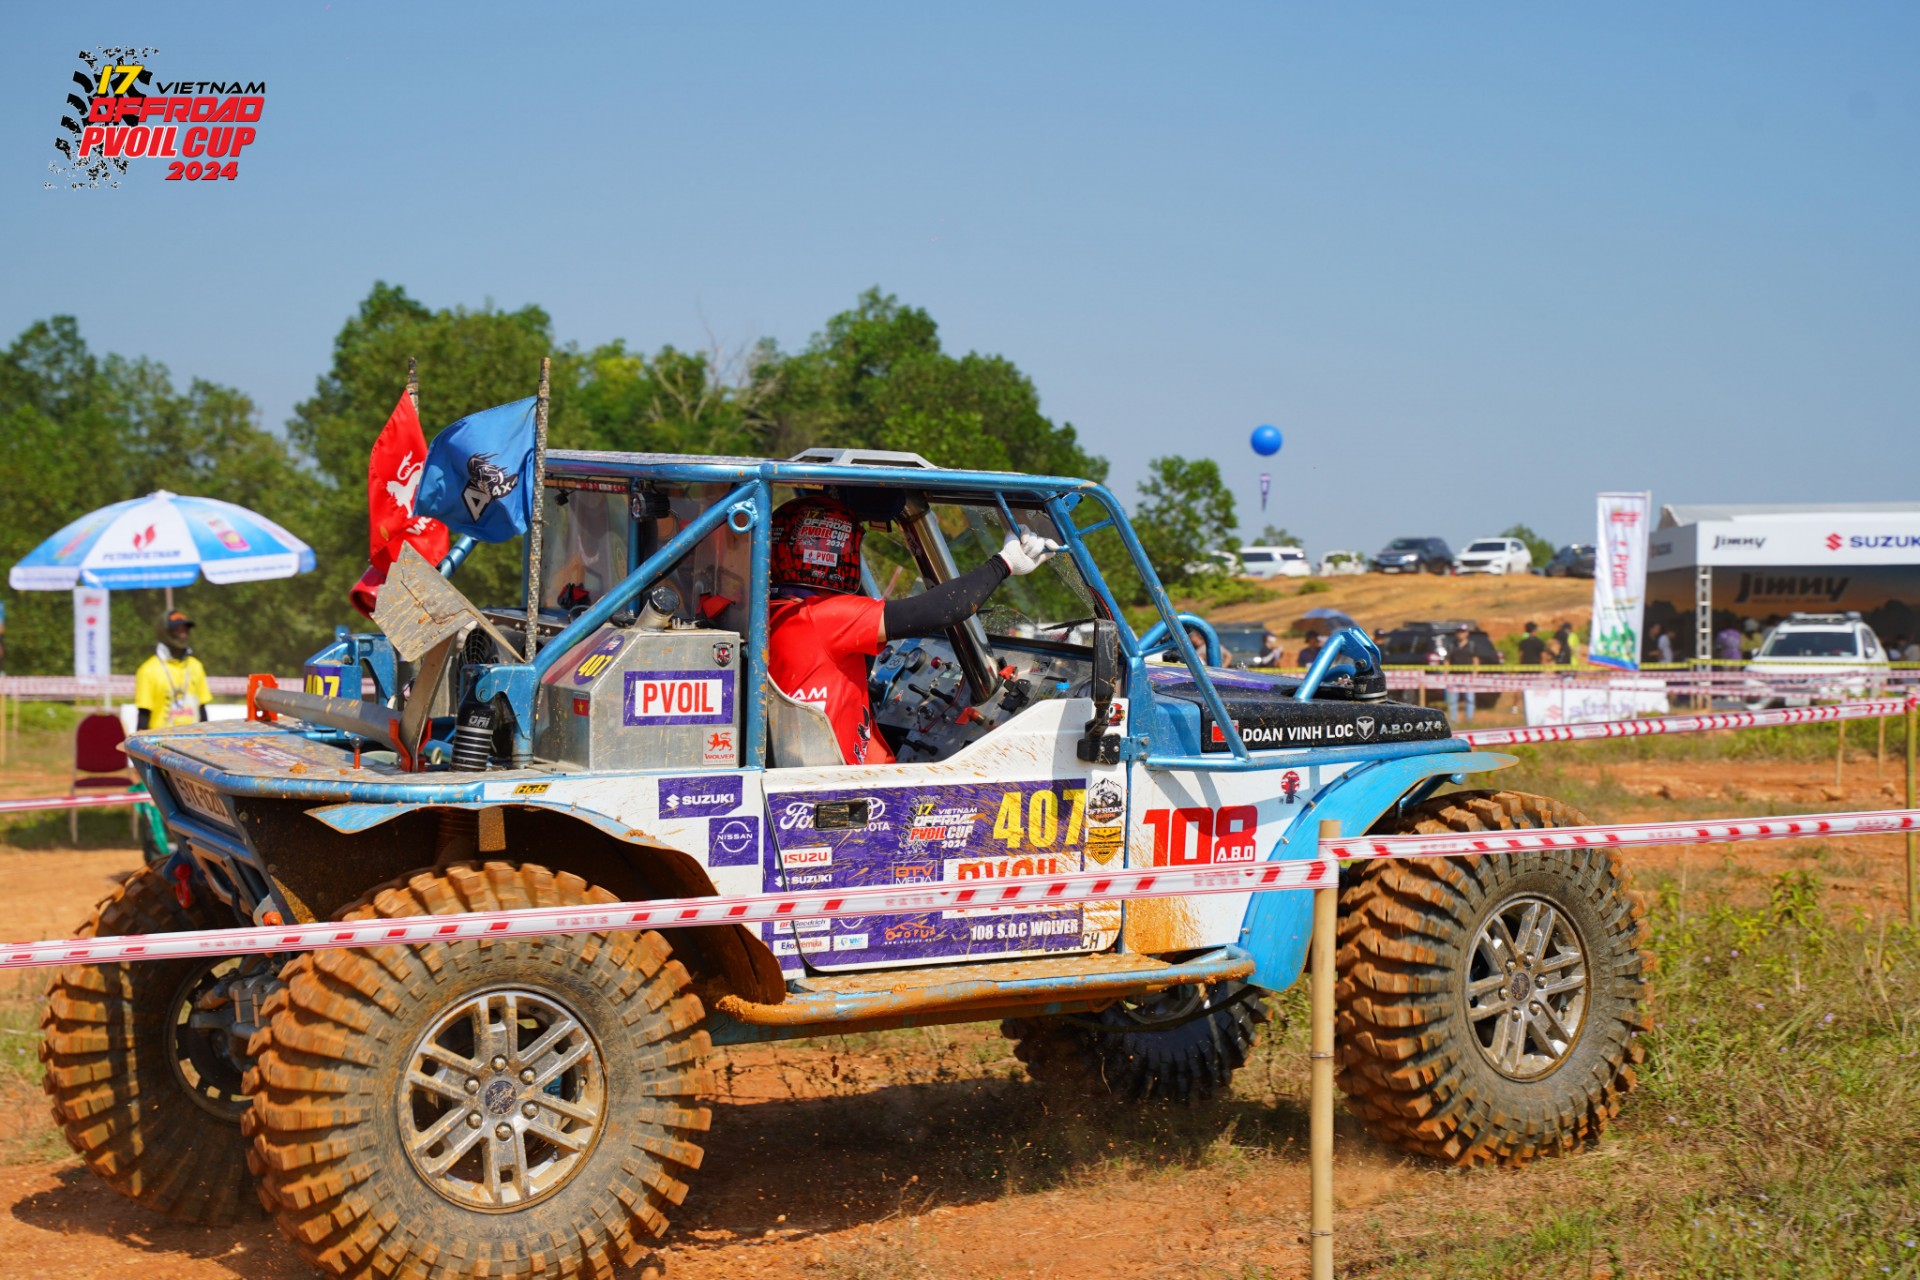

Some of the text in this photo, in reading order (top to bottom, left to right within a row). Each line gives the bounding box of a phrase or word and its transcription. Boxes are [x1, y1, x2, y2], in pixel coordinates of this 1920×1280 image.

[801, 525, 850, 541] PVOIL CUP
[803, 518, 852, 533] OFFROAD
[825, 540, 845, 548] 2024
[816, 552, 835, 563] PVOIL
[578, 654, 613, 677] 407
[643, 682, 714, 714] PVOIL
[1243, 724, 1354, 742] DOAN VINH LOC
[1379, 720, 1443, 735] A.B.O 4X4
[682, 794, 735, 805] SUZUKI
[780, 802, 815, 830] Fo
[917, 803, 935, 815] 17
[938, 807, 978, 815] VIETNAM
[993, 788, 1086, 850] 407
[717, 833, 753, 841] NISSAN
[910, 826, 974, 840] PVOIL CUP
[1143, 805, 1258, 868] 108
[942, 840, 967, 849] 2024
[783, 852, 828, 864] ISUZU
[1215, 845, 1255, 862] A.B.O
[791, 874, 832, 885] SUZUKI
[971, 925, 993, 941] 108
[1031, 918, 1079, 936] WOLVER
